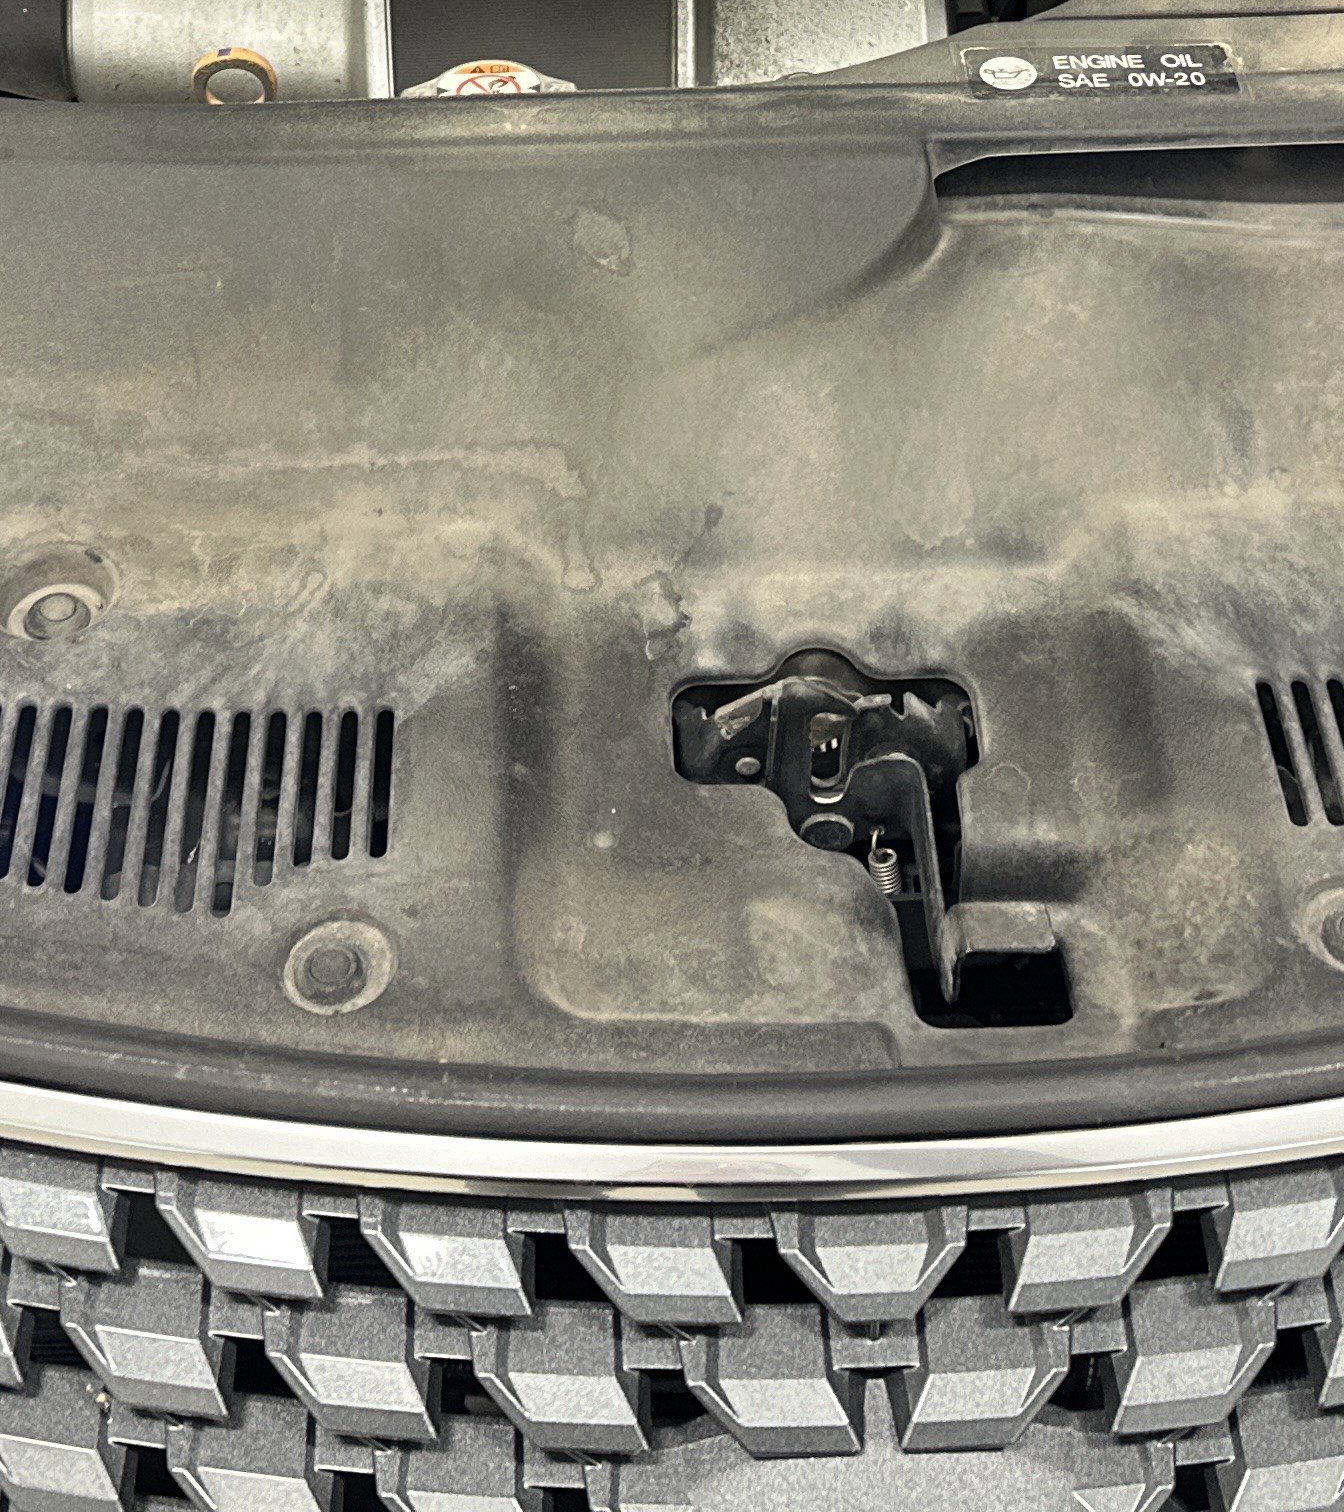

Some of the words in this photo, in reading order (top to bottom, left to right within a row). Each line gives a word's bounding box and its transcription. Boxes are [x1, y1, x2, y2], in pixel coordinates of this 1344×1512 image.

[1052, 54, 1145, 70] ENGINE
[1160, 53, 1203, 68] OIL
[1057, 73, 1110, 88] SAE
[1127, 71, 1206, 87] 0W-20
